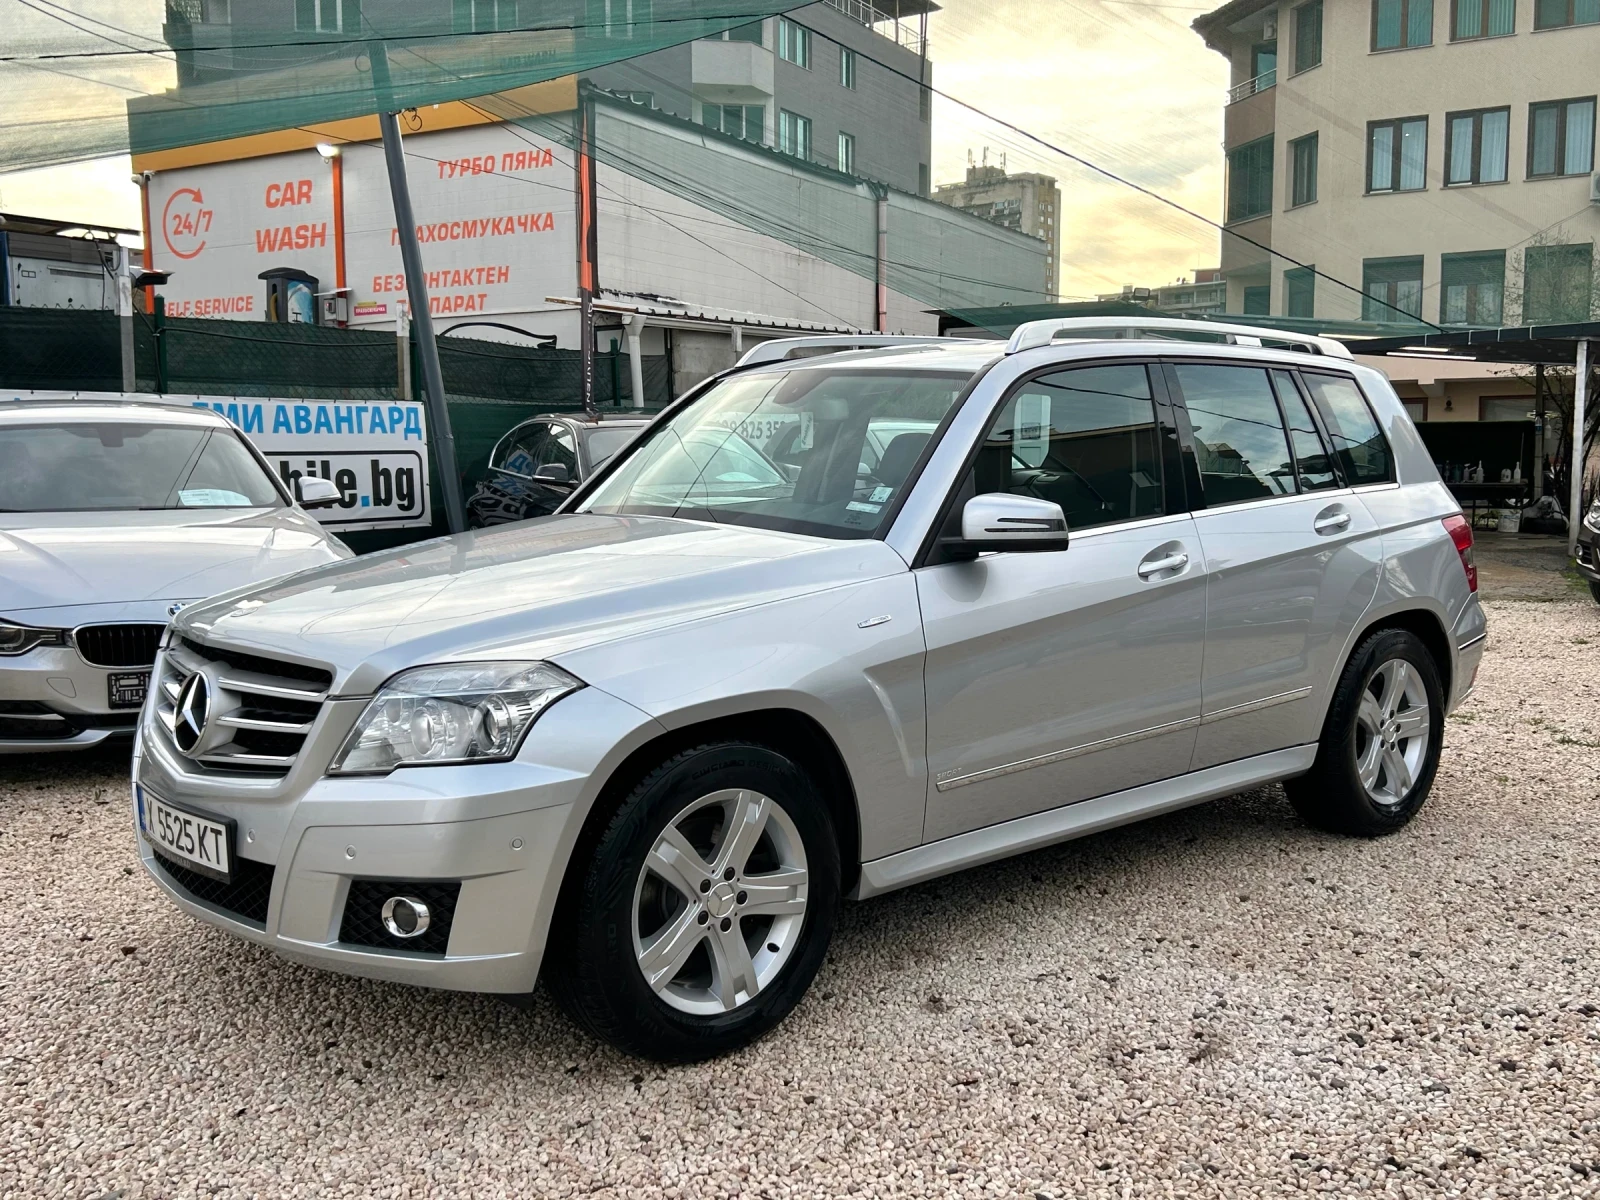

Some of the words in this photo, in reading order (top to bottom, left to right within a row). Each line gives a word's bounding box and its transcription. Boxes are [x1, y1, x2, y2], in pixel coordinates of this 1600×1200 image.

[438, 155, 496, 180] ТУРБО
[501, 148, 553, 172] ПЯНА
[265, 179, 313, 209] CAR
[172, 208, 213, 237] 24/7
[256, 222, 327, 253] WASH
[391, 212, 555, 246] ПАХОСМУКАЧКА
[373, 265, 510, 293] БЕЗНТАКТЕН
[194, 295, 253, 316] SERVICE
[192, 402, 264, 434] МИ
[272, 405, 423, 440] АВАНГАРД
[741, 421, 763, 439] 825
[146, 798, 155, 834] X
[157, 806, 195, 855] 5525
[197, 823, 222, 865] KT
